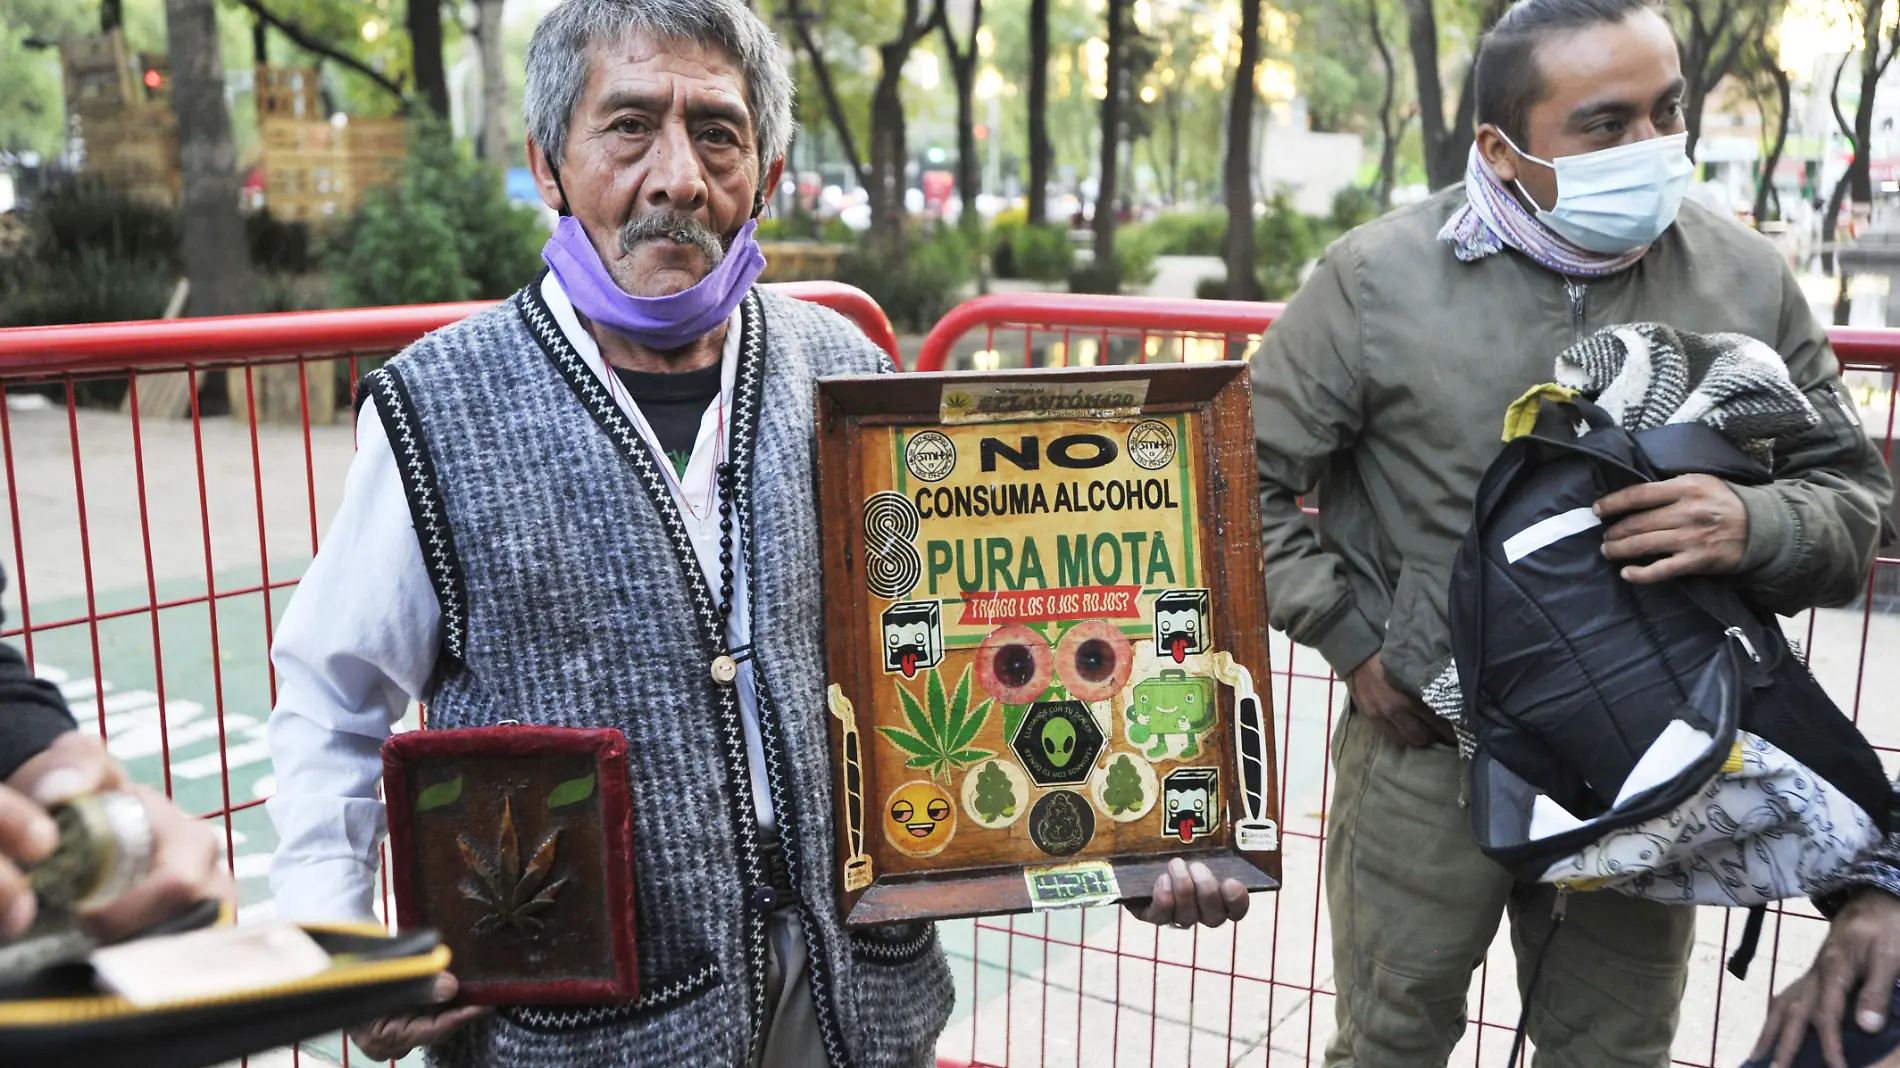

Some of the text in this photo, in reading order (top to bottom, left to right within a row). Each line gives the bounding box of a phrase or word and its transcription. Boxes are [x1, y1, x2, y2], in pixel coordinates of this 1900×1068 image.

[1008, 387, 1035, 395] apoyo
[980, 434, 1119, 473] NO
[915, 478, 1179, 519] CONSUMA ALCOHOL
[927, 530, 1176, 595] PURA MOTA
[1019, 596, 1044, 617] LOS
[1046, 593, 1080, 615] OJOS
[1082, 591, 1130, 613] ROJOS?
